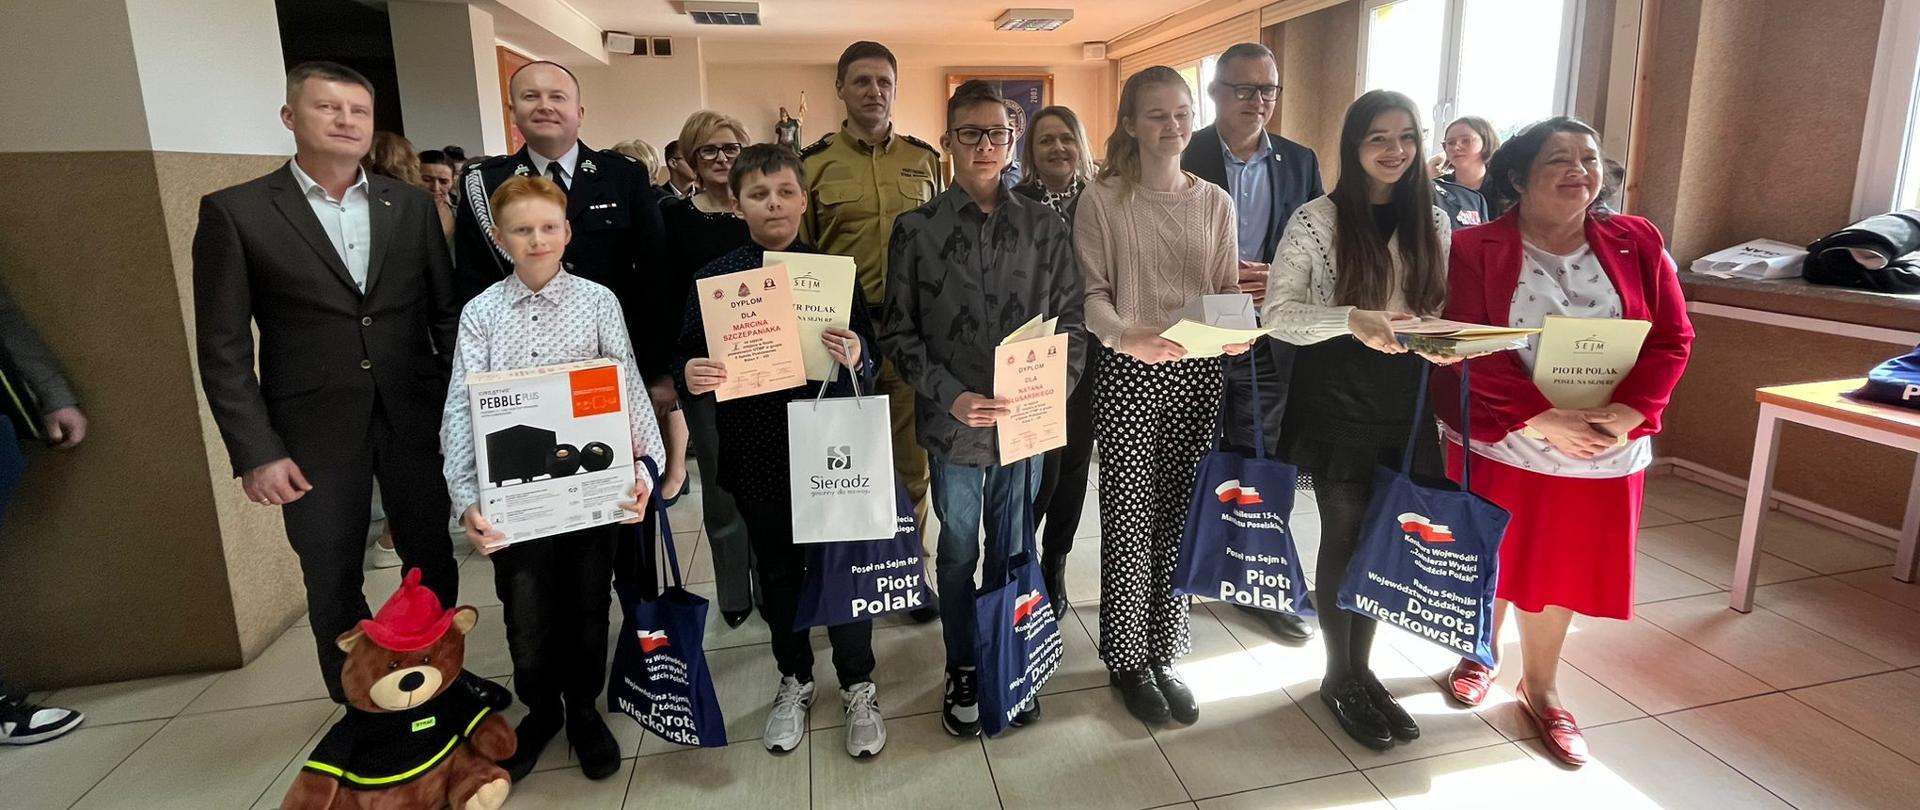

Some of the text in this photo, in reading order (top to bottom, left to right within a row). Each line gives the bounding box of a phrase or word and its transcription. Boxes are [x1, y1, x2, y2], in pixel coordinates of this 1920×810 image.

[794, 279, 820, 289] SEJM
[730, 297, 763, 309] DYPLOM
[805, 304, 836, 313] POLAK
[741, 311, 757, 319] DLA
[732, 319, 769, 331] MARCINA
[722, 325, 781, 342] SZCZEPANIAKA
[1575, 342, 1604, 351] SEJM
[1552, 366, 1618, 376] PIOTR POLAK
[480, 391, 540, 410] PEBBLE PLUS
[810, 474, 870, 490] Sieradz
[874, 563, 885, 571] na
[886, 559, 907, 569] Sejm
[907, 557, 919, 565] RP
[1257, 553, 1280, 566] Sejm
[876, 574, 920, 593] Piotr
[1246, 569, 1291, 590] Piotr
[1413, 578, 1439, 597] Radna
[851, 589, 922, 618] Polak
[1220, 581, 1296, 613] Polak
[1355, 594, 1474, 653] Więckowska
[1407, 597, 1475, 635] Dorota
[618, 696, 700, 746] Więckowska
